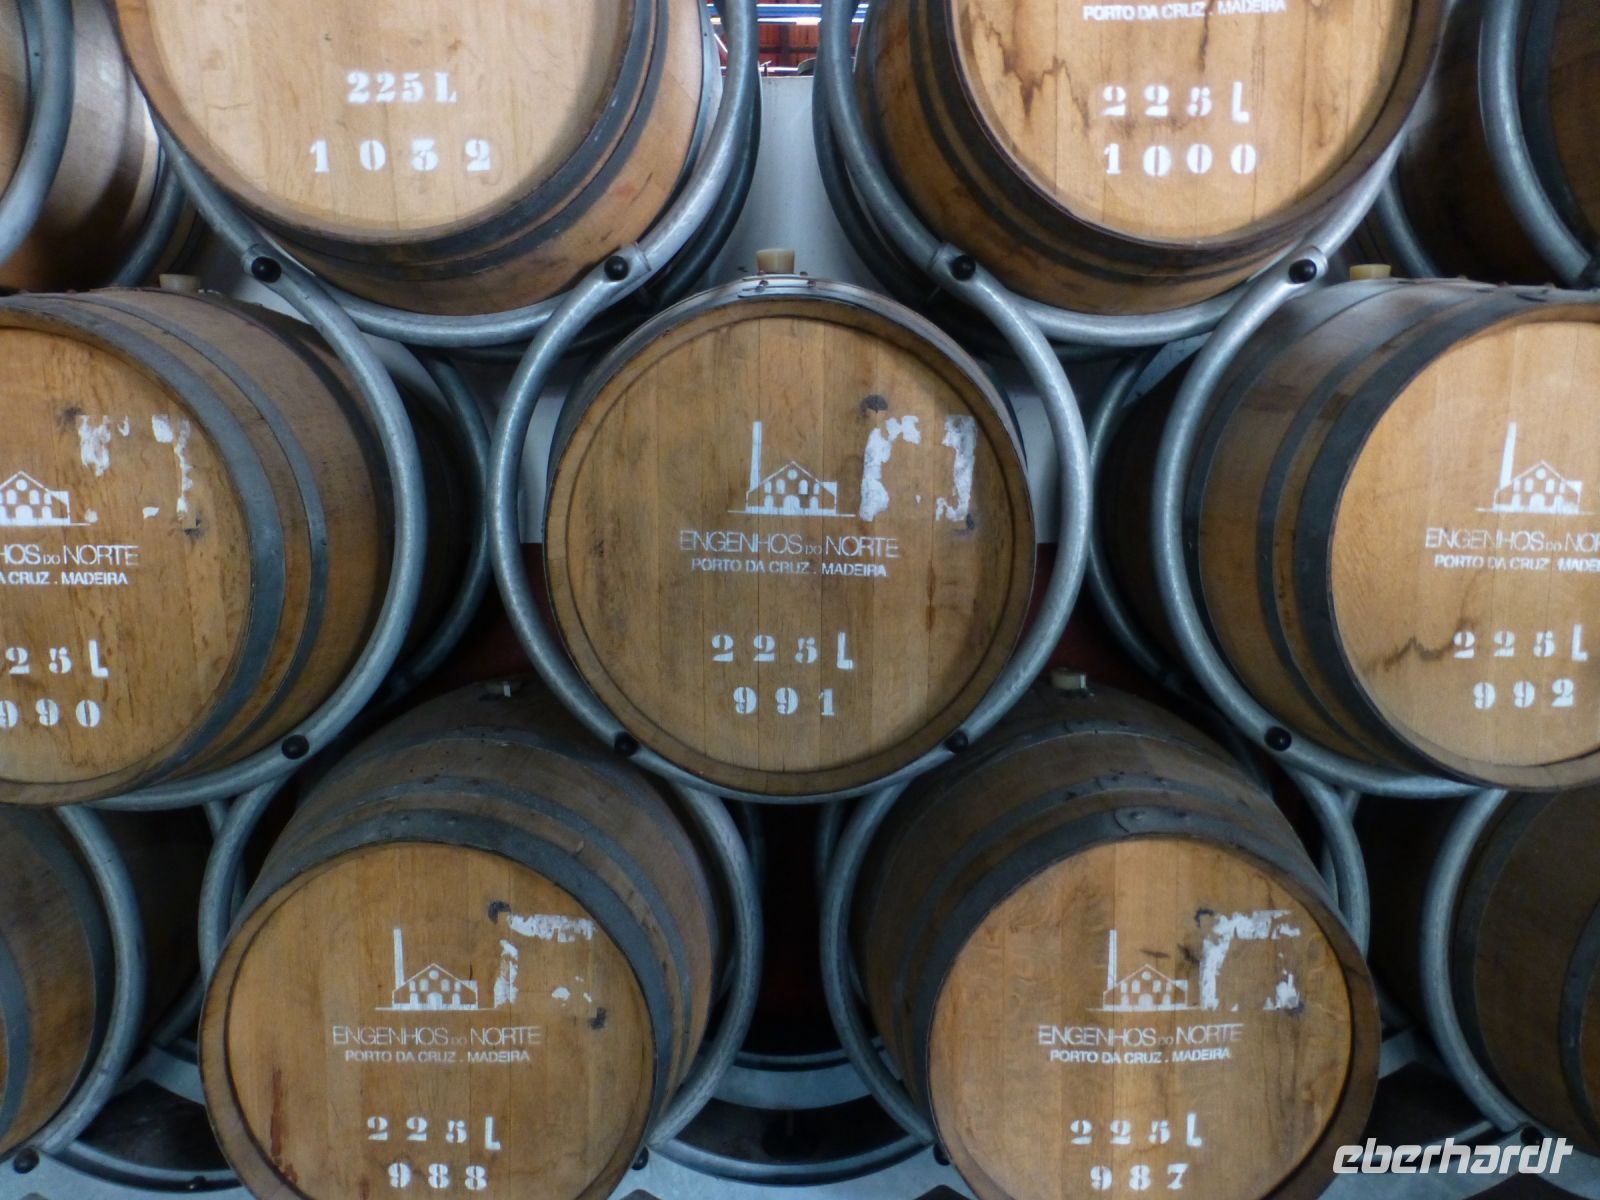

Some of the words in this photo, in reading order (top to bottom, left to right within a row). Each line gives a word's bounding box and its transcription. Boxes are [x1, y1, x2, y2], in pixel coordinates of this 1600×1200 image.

[1082, 5, 1136, 21] PORTO
[1138, 5, 1159, 20] DA
[1161, 3, 1206, 19] CRUZ
[1217, 0, 1287, 15] MADEIRA
[1103, 143, 1257, 176] 1000
[680, 531, 802, 554] ENGENHOS
[825, 535, 900, 558] NORTE
[1425, 527, 1546, 551] ENGENHOS
[63, 544, 139, 566] NORTE
[1434, 554, 1484, 568] PORTO
[1487, 556, 1506, 570] DA
[1509, 556, 1551, 570] CRUZ
[8, 571, 50, 585] CRUZ
[61, 571, 128, 585] MADEIRA
[691, 558, 742, 572] PORTO
[745, 560, 765, 573] DA
[768, 560, 811, 574] CRUZ
[821, 562, 888, 577] MADEIRA
[733, 687, 835, 716] 991
[1473, 678, 1574, 710] 992
[332, 1025, 449, 1046] ENGENHOS
[470, 1026, 543, 1046] NORTE
[1038, 1025, 1157, 1047] ENGENHOS
[1175, 1023, 1244, 1045] NORTE
[345, 1051, 392, 1062] PORTO
[396, 1051, 415, 1062] DA
[418, 1051, 457, 1063] CRUZ
[467, 1051, 530, 1063] MADEIRA
[1050, 1049, 1098, 1063] PORTO
[1102, 1051, 1121, 1064] DA
[1124, 1051, 1162, 1064] CRUZ
[1172, 1047, 1230, 1063] MADEIRA
[388, 1162, 487, 1191] 988
[1090, 1163, 1189, 1191] 987
